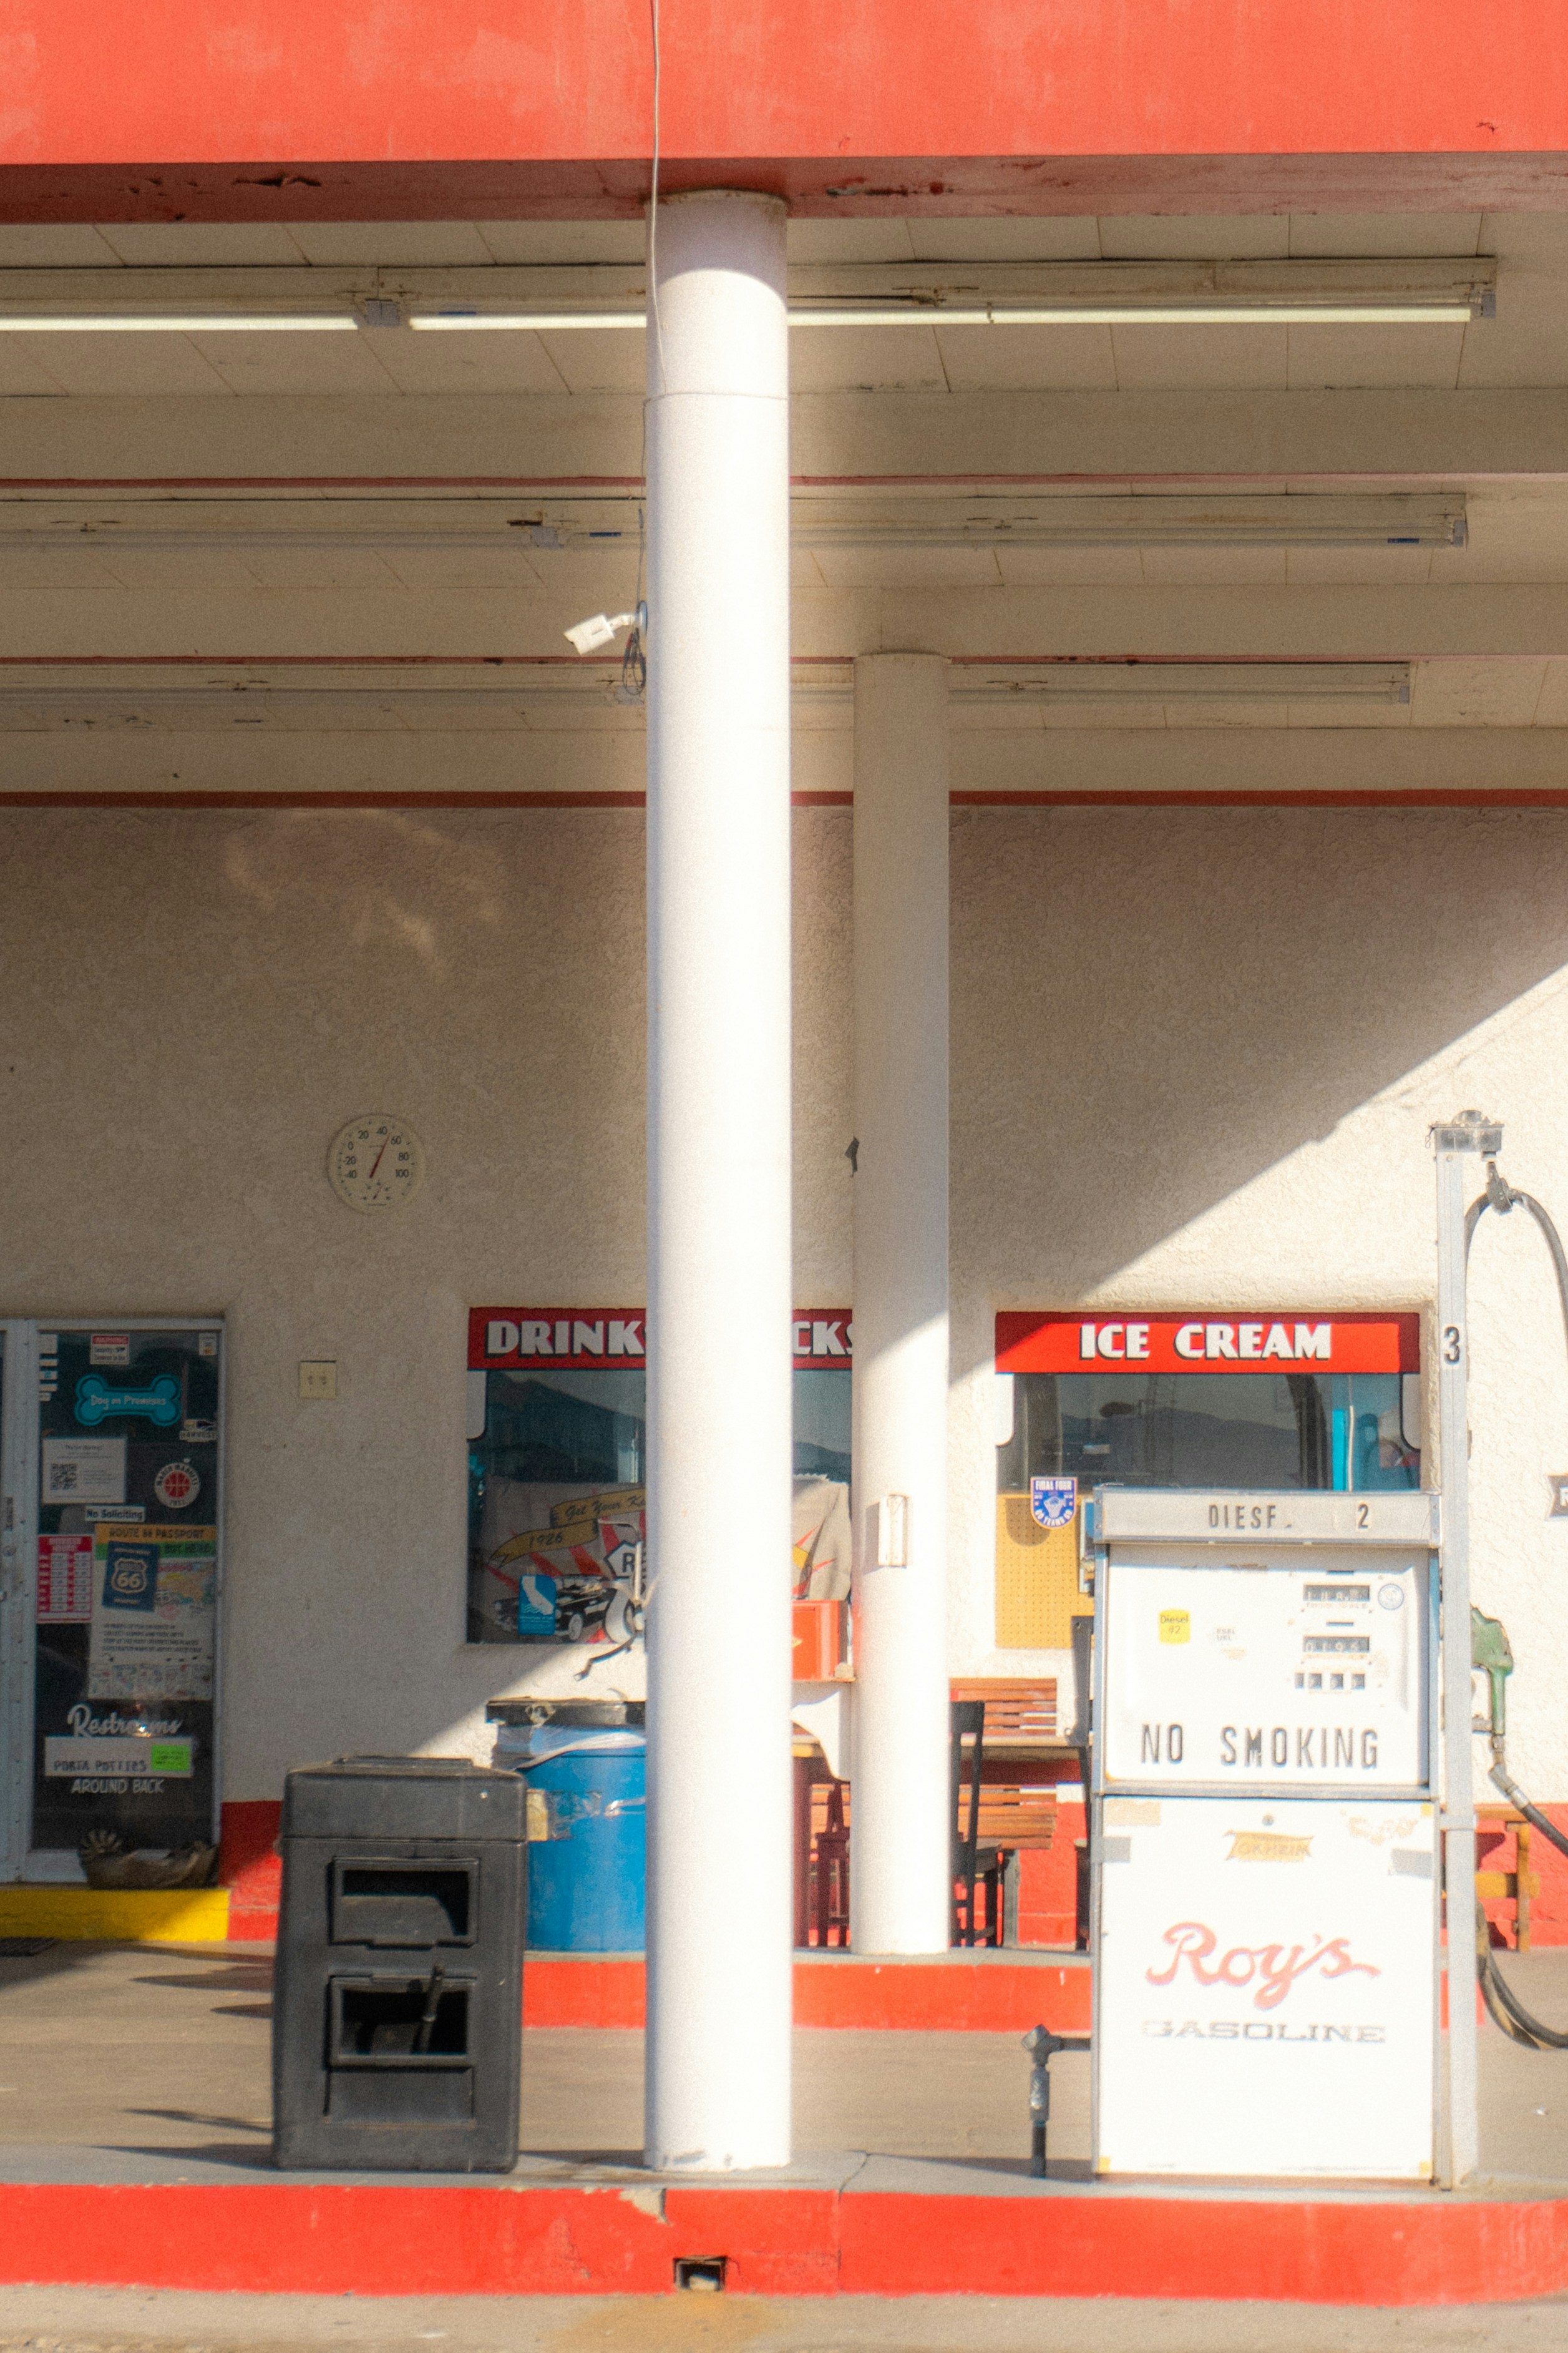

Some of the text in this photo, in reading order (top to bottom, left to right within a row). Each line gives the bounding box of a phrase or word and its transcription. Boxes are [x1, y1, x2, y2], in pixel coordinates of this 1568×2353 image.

[358, 1130, 369, 1139] 20
[376, 1126, 387, 1135] 40
[348, 1142, 354, 1150] 0
[391, 1136, 401, 1145] 60
[399, 1152, 409, 1161] 80
[395, 1169, 409, 1178] 100
[485, 1320, 646, 1358] DRINK
[1080, 1323, 1330, 1360] ICE CREAM
[1444, 1326, 1460, 1365] 3
[91, 1394, 109, 1411] Dog
[124, 1395, 167, 1406] Premises
[1035, 1480, 1072, 1490] FINAL FOUR
[86, 1509, 143, 1519] No Soliciting
[565, 1504, 587, 1520] Get
[592, 1500, 621, 1514] Your
[1043, 1516, 1065, 1527] TEAMS
[1357, 1504, 1369, 1528] 2
[109, 1528, 140, 1537] ROUTE
[155, 1529, 205, 1539] PASSPORT
[117, 1572, 141, 1588] 66
[1159, 1615, 1189, 1624] Diesel
[1141, 1723, 1378, 1769] NO SMOKING
[54, 1760, 90, 1771] PORTA
[71, 1778, 165, 1794] AROUND BACK
[1145, 1921, 1381, 2011] Roy's
[1141, 2018, 1387, 2043] GASOLINE
